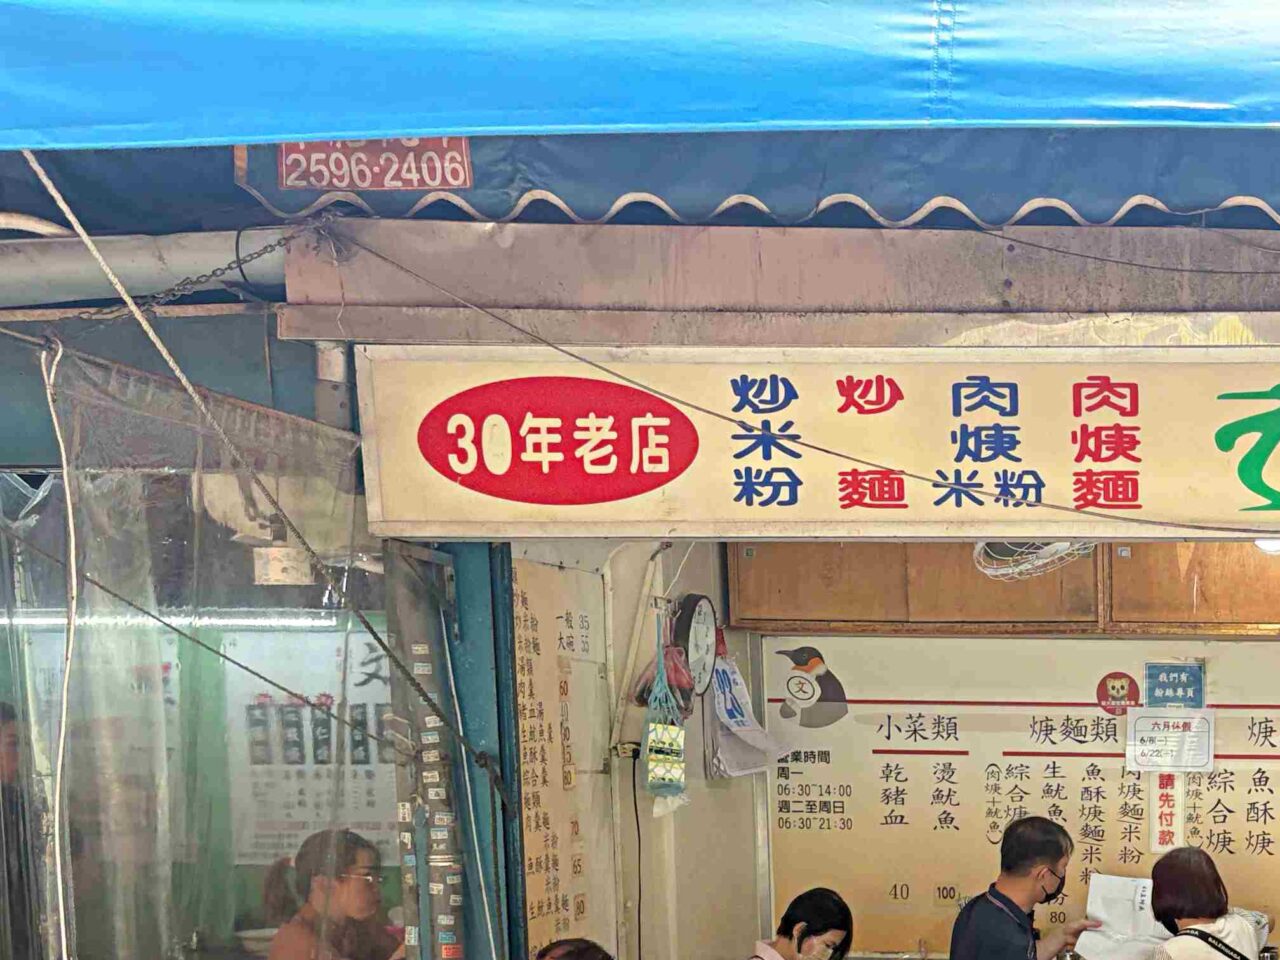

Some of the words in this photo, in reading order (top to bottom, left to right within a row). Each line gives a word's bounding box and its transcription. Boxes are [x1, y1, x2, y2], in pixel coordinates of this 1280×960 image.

[447, 412, 670, 475] 30年老店
[730, 374, 804, 507] 炒米粉
[837, 374, 909, 509] 炒麵
[876, 712, 960, 743] 小菜類
[1151, 721, 1191, 732] 六月休假
[879, 762, 909, 826] 乾豬血
[930, 761, 960, 831] 燙魷魚
[1157, 773, 1176, 846] 請先付款
[888, 883, 910, 900] 40
[936, 886, 956, 899] 100
[1049, 911, 1066, 924] 80
